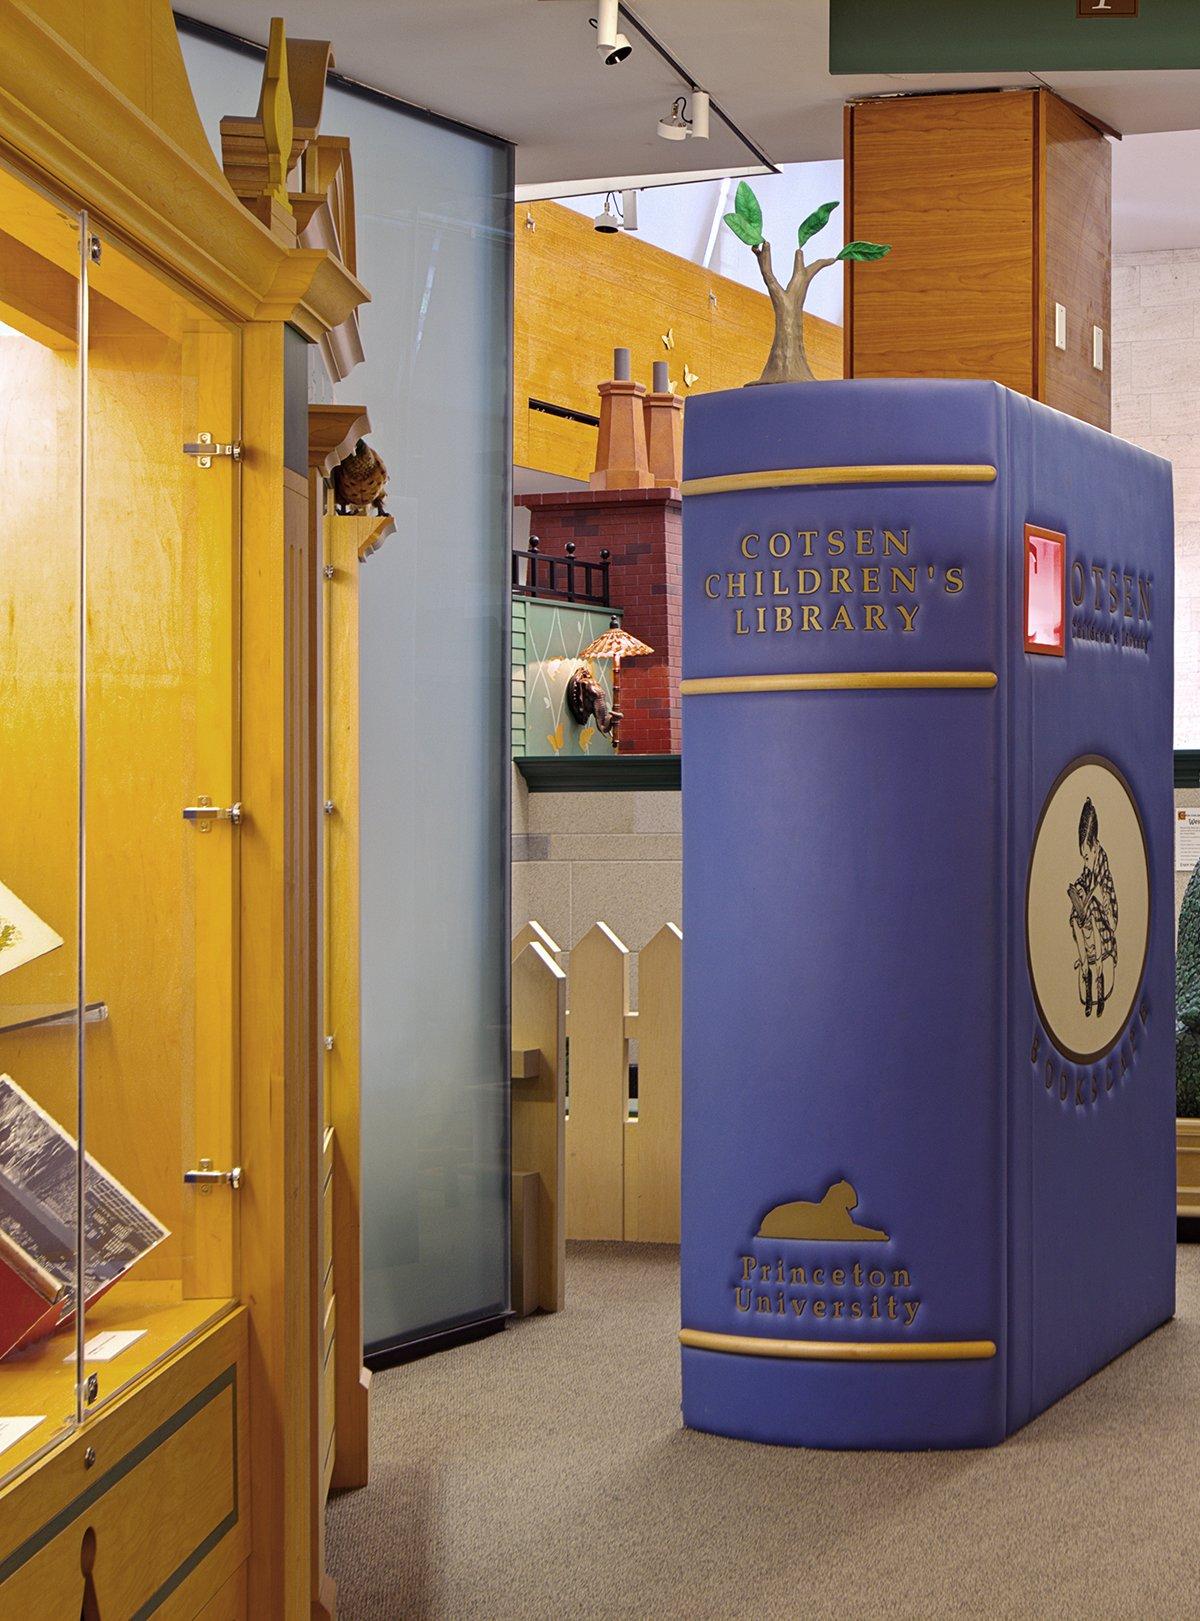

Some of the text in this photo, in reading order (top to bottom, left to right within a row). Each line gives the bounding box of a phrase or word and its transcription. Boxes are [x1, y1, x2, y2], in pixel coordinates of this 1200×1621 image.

[740, 528, 910, 560] COTSEN
[704, 565, 966, 600] CHILDREN'S
[735, 603, 920, 635] LIBRARY
[740, 1255, 911, 1287] Princeton
[734, 1286, 922, 1326] University
